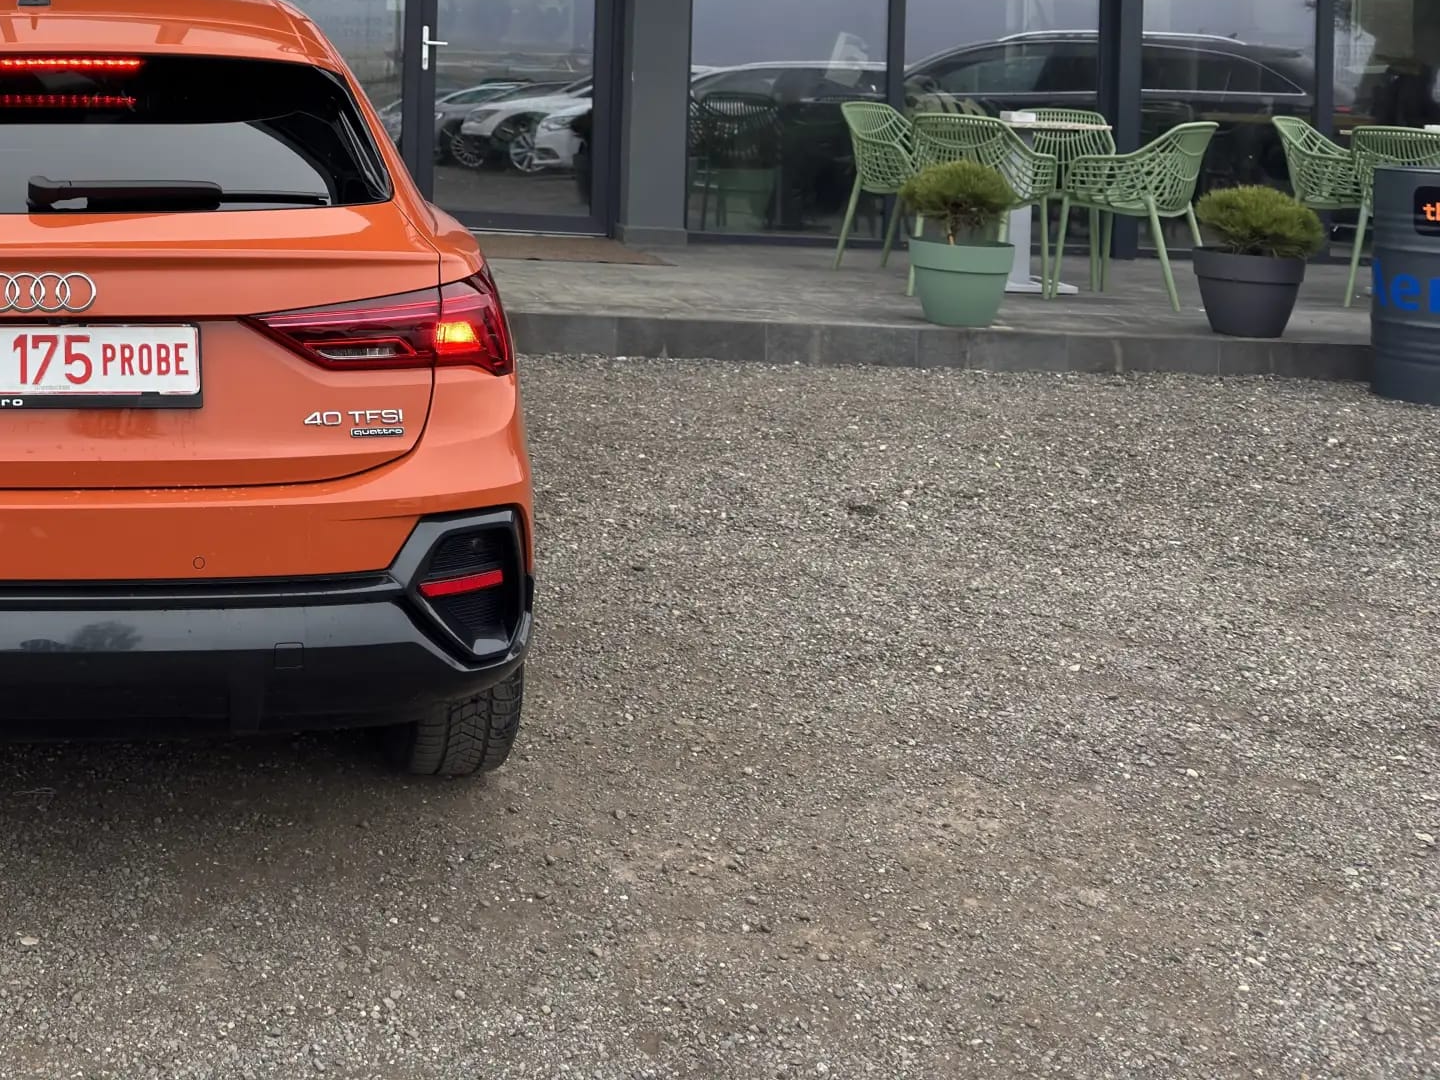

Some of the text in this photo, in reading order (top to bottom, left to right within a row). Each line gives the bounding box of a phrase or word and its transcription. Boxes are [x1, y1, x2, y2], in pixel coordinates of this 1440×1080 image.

[13, 334, 93, 385] 175
[101, 343, 189, 376] PROBE
[303, 409, 403, 426] 40 TFSI
[353, 428, 403, 436] quattro
